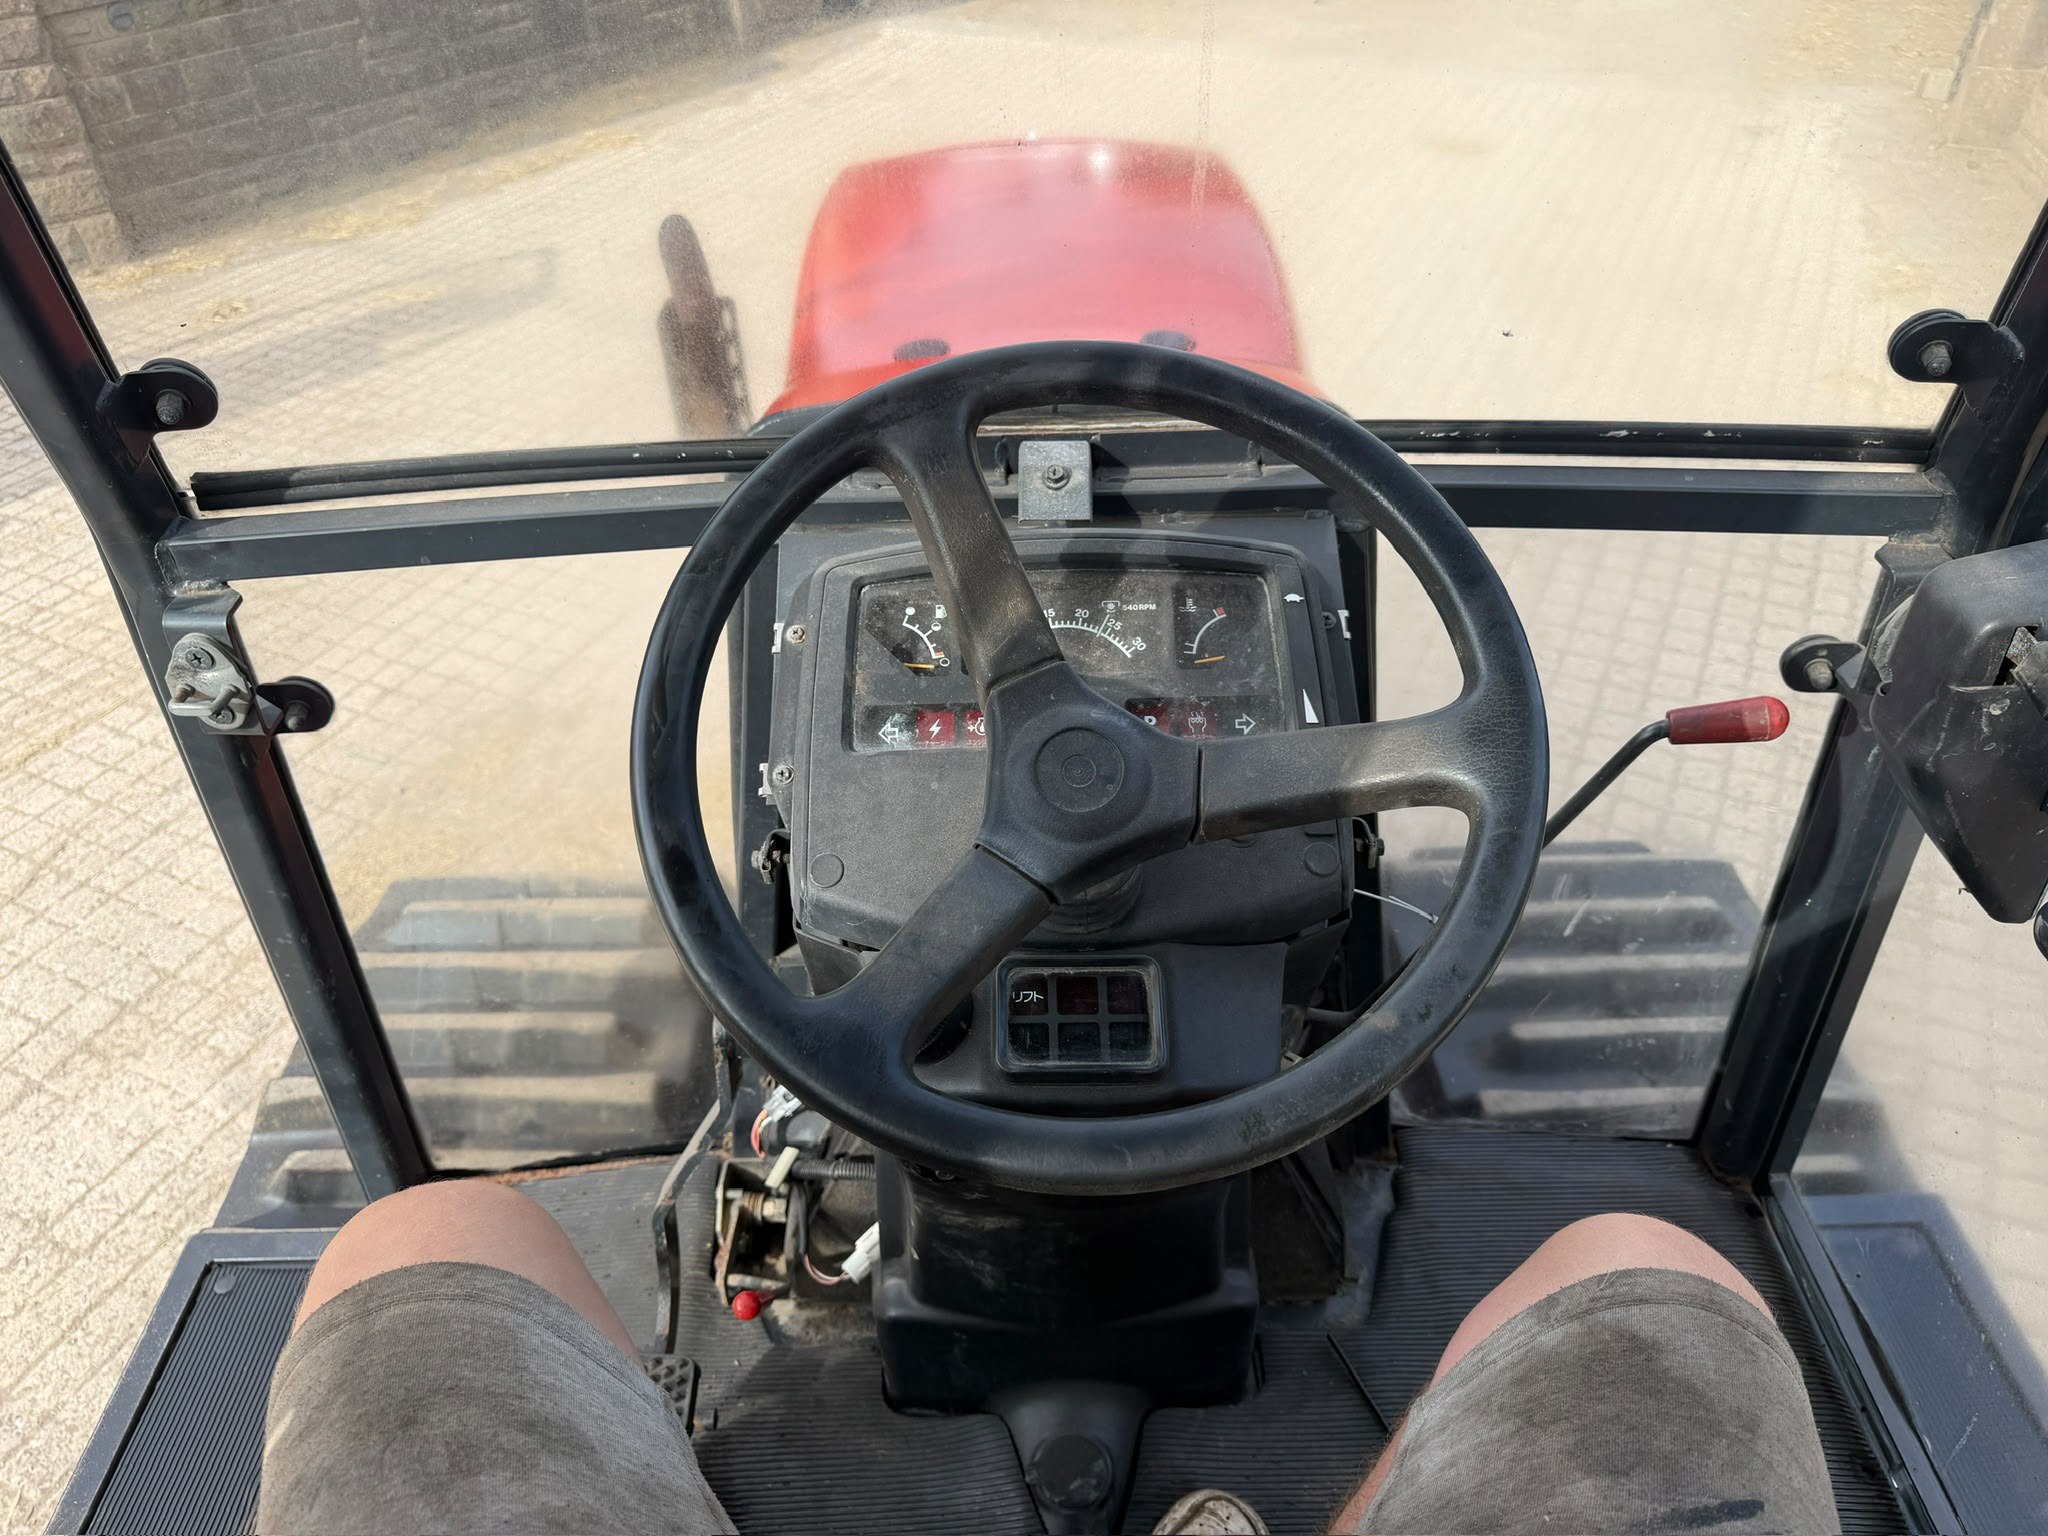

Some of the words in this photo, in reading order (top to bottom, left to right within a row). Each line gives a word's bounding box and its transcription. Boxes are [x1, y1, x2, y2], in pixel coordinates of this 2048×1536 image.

[1043, 608, 1055, 617] 15
[1075, 609, 1089, 617] 20
[1107, 619, 1122, 630] 25
[1132, 637, 1146, 650] 30
[1013, 991, 1044, 1002] リフト
